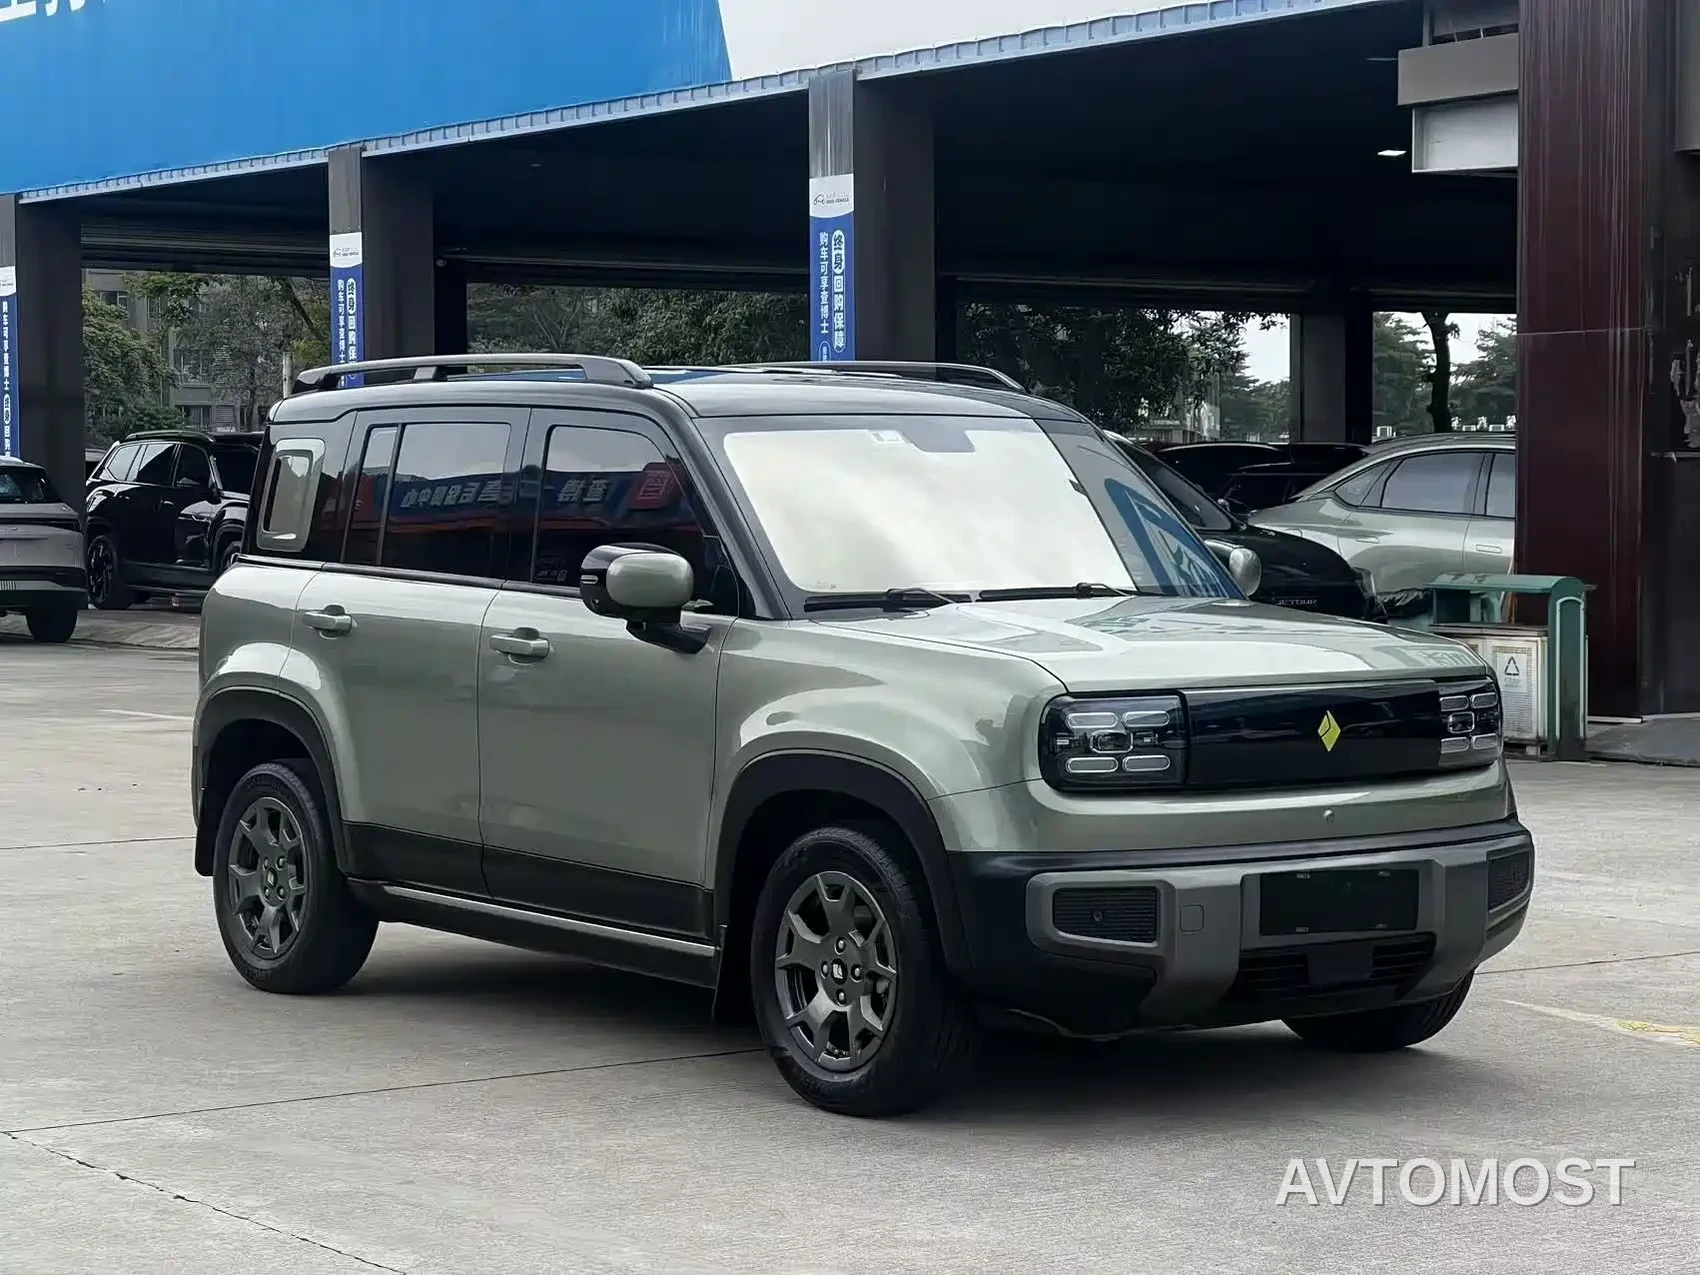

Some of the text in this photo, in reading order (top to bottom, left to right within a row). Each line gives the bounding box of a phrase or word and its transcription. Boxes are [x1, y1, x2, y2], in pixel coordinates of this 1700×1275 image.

[347, 281, 357, 364] 终身回购保
[819, 231, 829, 334] 购车可享查博士
[833, 233, 845, 349] 终身回购保障
